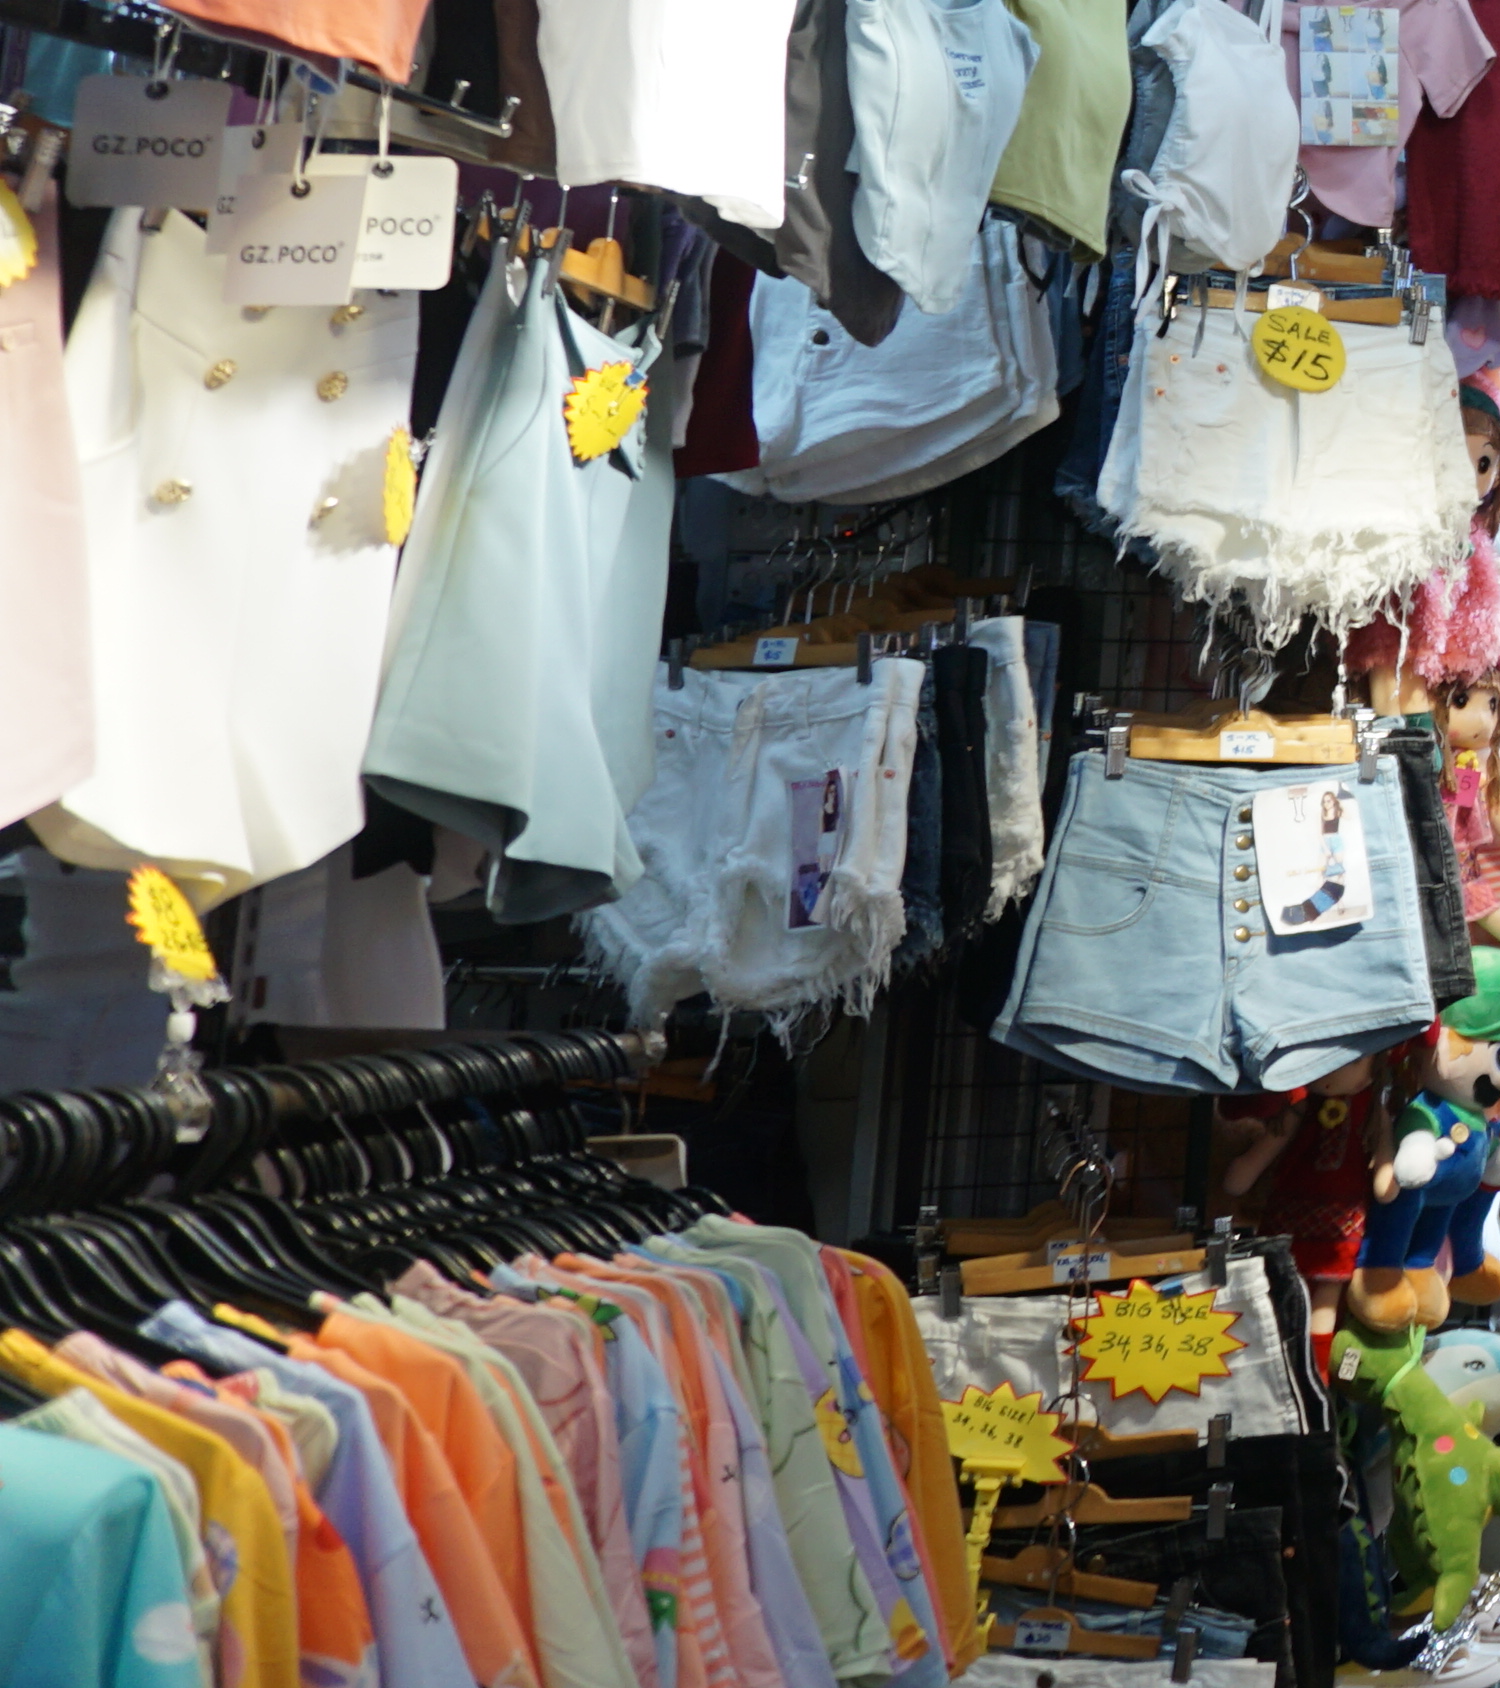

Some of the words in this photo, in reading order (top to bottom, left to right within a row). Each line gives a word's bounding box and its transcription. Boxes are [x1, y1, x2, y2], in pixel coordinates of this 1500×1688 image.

[93, 135, 205, 157] GZ.POCO
[240, 245, 338, 264] GZ.POCO
[1267, 314, 1331, 347] SALE
[1262, 338, 1333, 381] $15
[1115, 1302, 1152, 1319] BIG
[1160, 1305, 1211, 1320] SIZE
[1098, 1332, 1131, 1361] 34,
[1139, 1334, 1169, 1361] 36,
[1177, 1334, 1214, 1356] 38
[973, 1396, 993, 1413] BIG
[1003, 1432, 1024, 1449] 38
